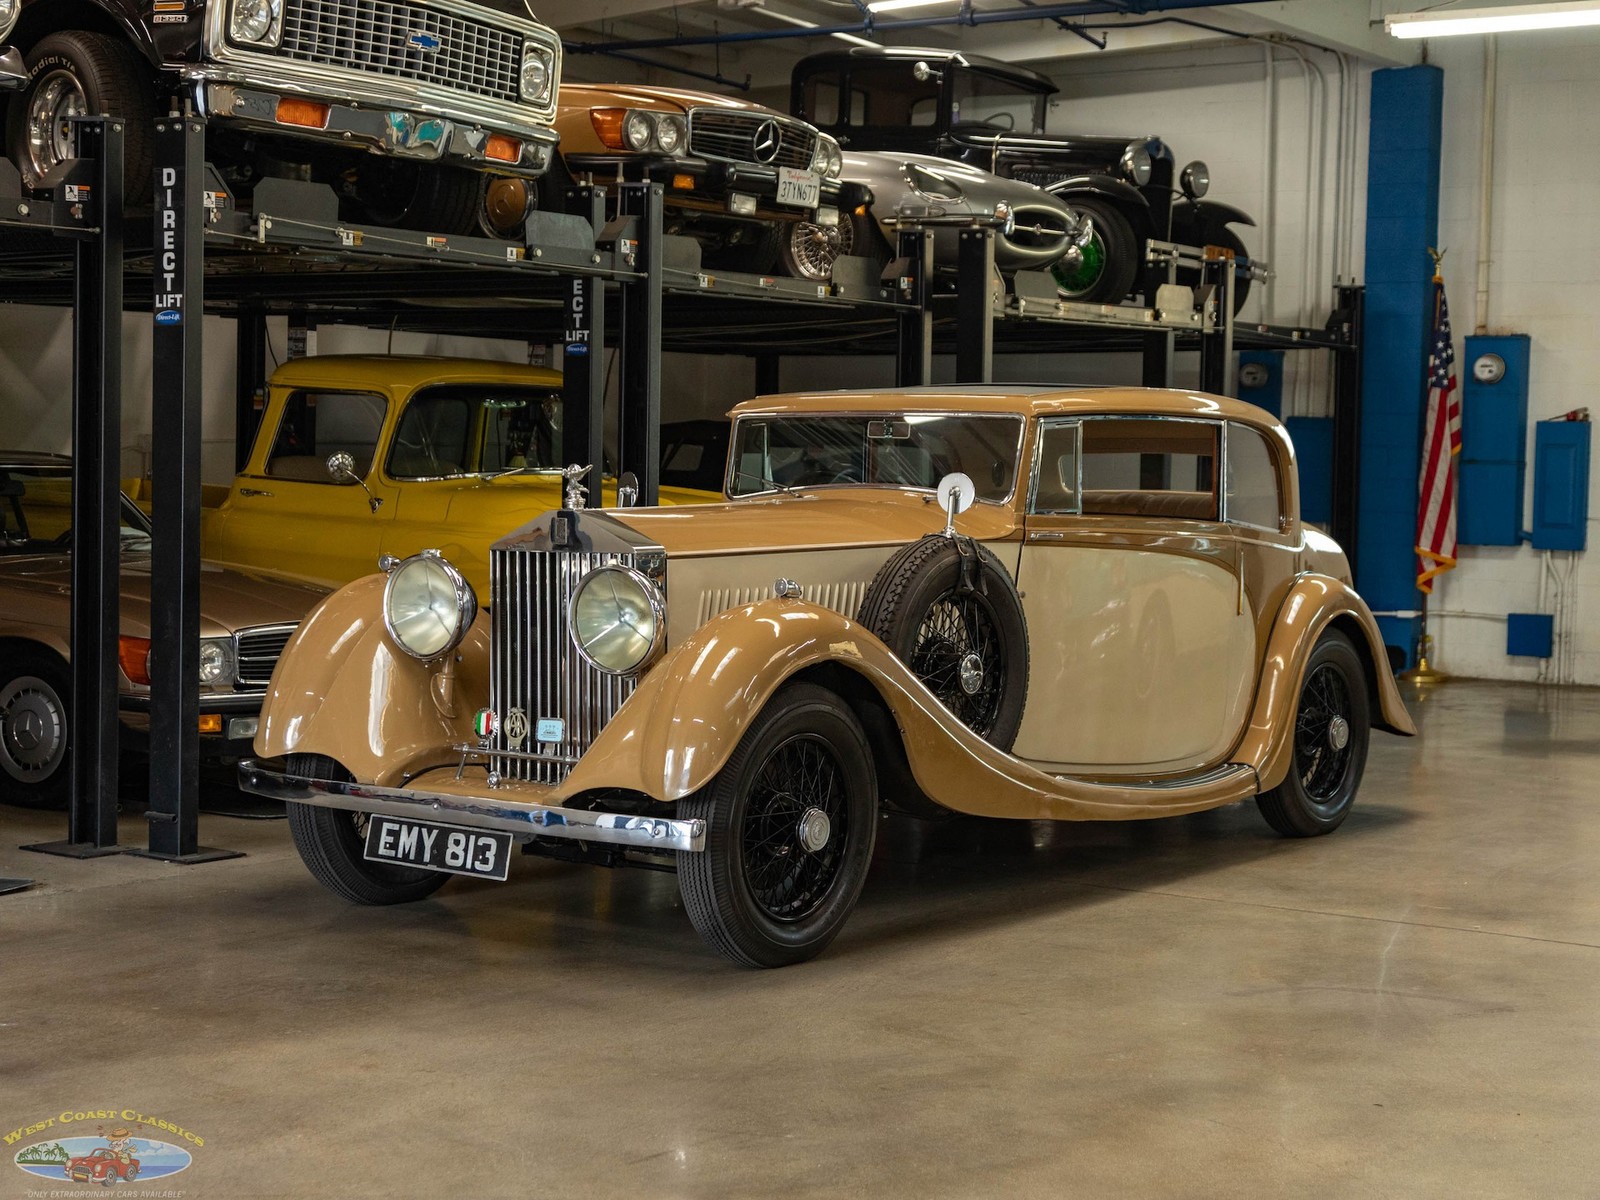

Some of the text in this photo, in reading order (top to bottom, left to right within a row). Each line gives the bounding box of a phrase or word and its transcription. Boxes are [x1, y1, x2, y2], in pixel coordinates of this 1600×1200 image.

[31, 56, 59, 76] adial
[780, 180, 818, 203] 3TYN677
[162, 167, 176, 292] DIRECT
[155, 293, 183, 308] LIFT
[572, 279, 584, 328] ECT
[565, 329, 590, 341] LIFT
[378, 822, 497, 872] EMY 813
